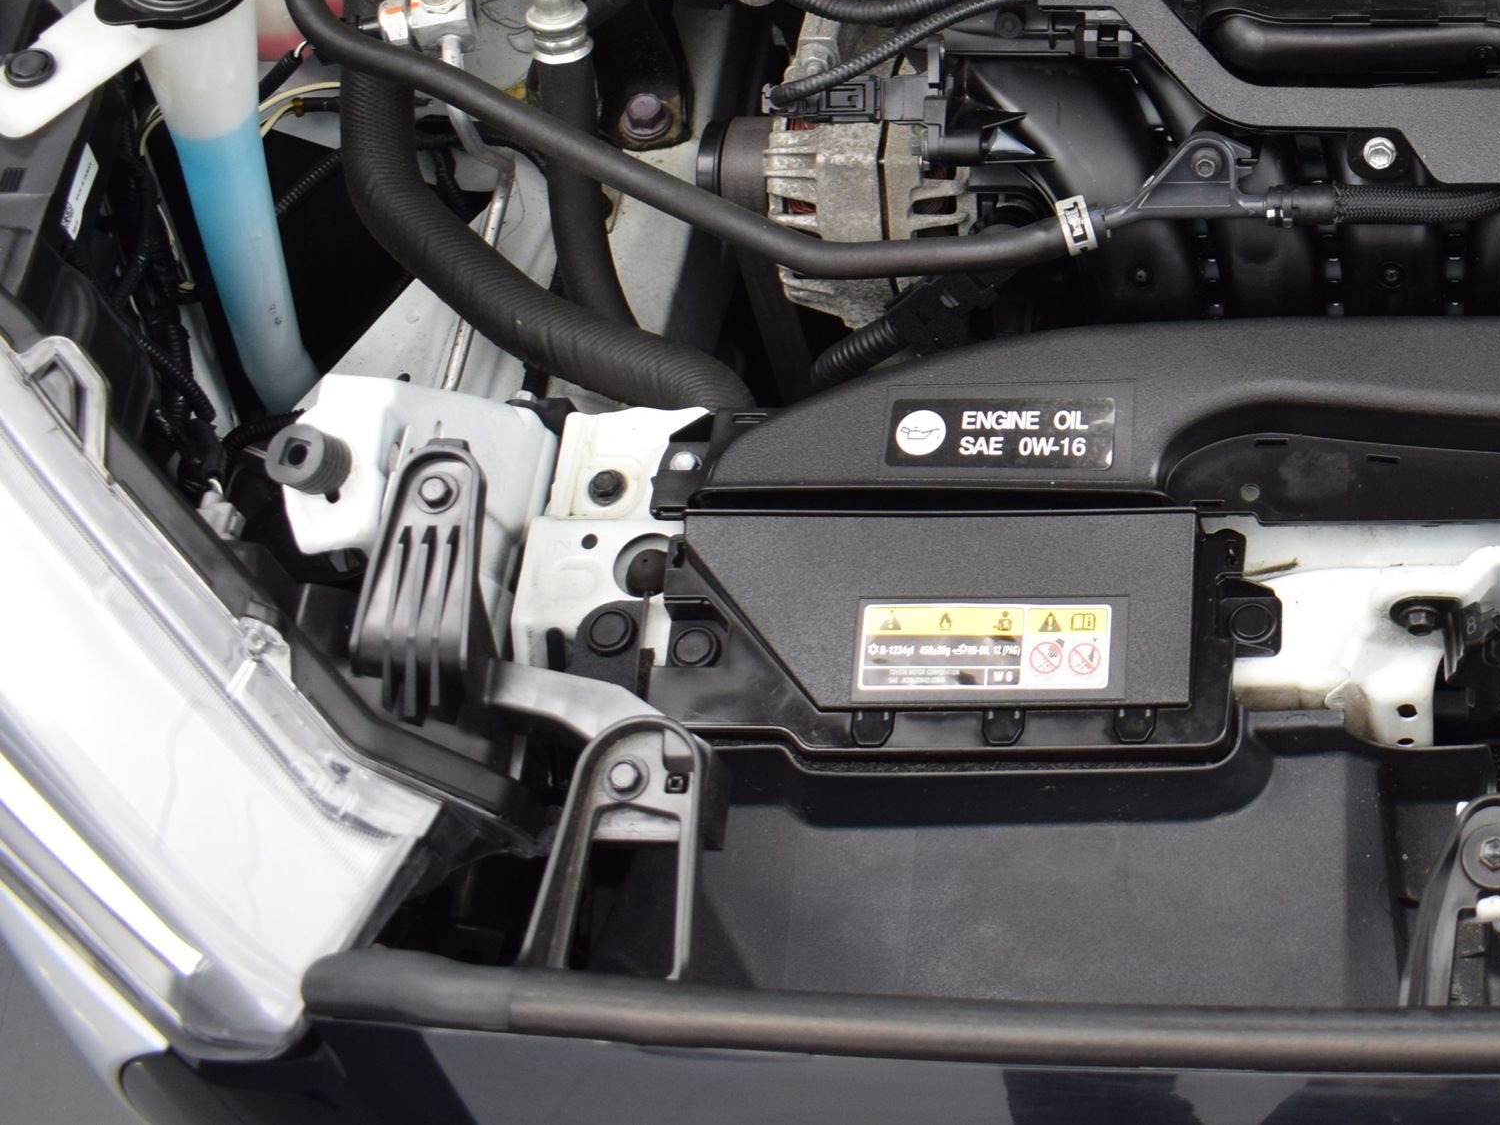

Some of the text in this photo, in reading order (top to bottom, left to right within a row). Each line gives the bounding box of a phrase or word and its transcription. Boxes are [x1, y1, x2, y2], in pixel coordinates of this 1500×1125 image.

[961, 410, 1089, 430] ENGINE OIL
[958, 436, 1087, 456] SAE 0W-16
